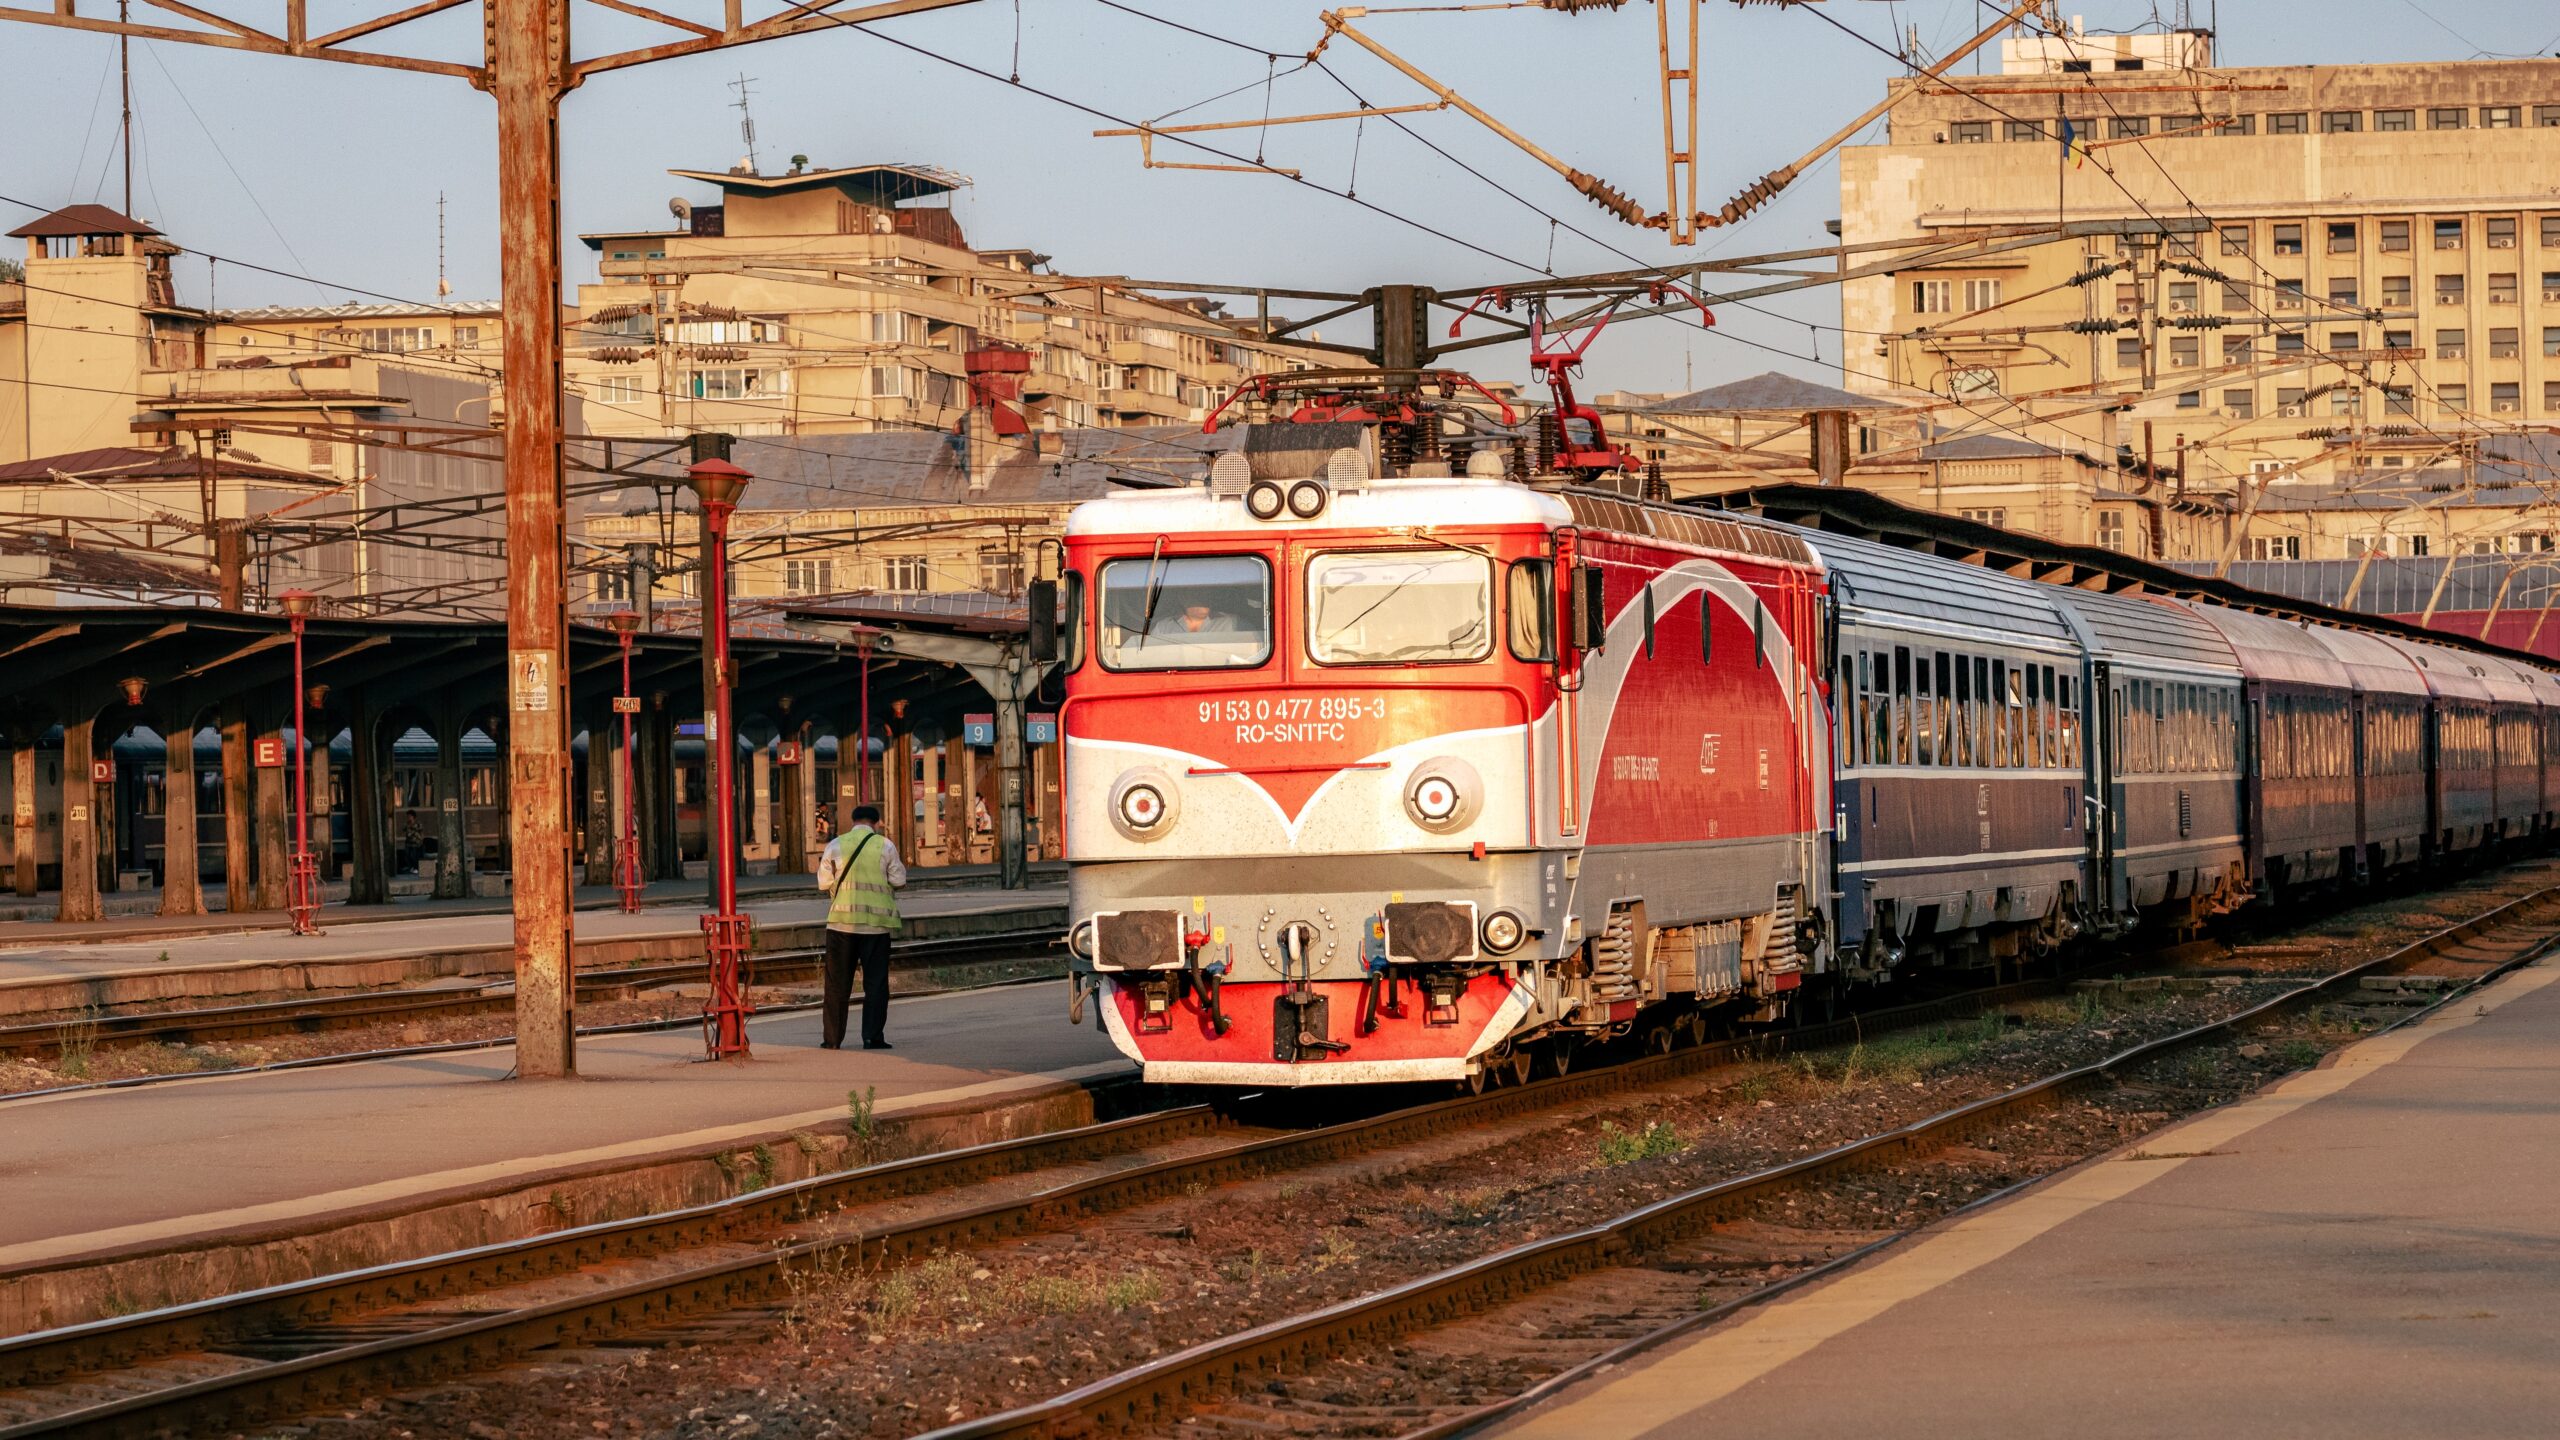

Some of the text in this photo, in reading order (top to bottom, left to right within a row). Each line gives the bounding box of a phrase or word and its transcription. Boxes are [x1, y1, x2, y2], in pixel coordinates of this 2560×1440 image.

[1199, 697, 1385, 723] 91 53 0 477 895-3
[974, 726, 984, 742] 9
[1036, 725, 1046, 740] 8
[1236, 722, 1345, 743] RO-SNTFC
[260, 743, 275, 763] E
[95, 763, 108, 778] D
